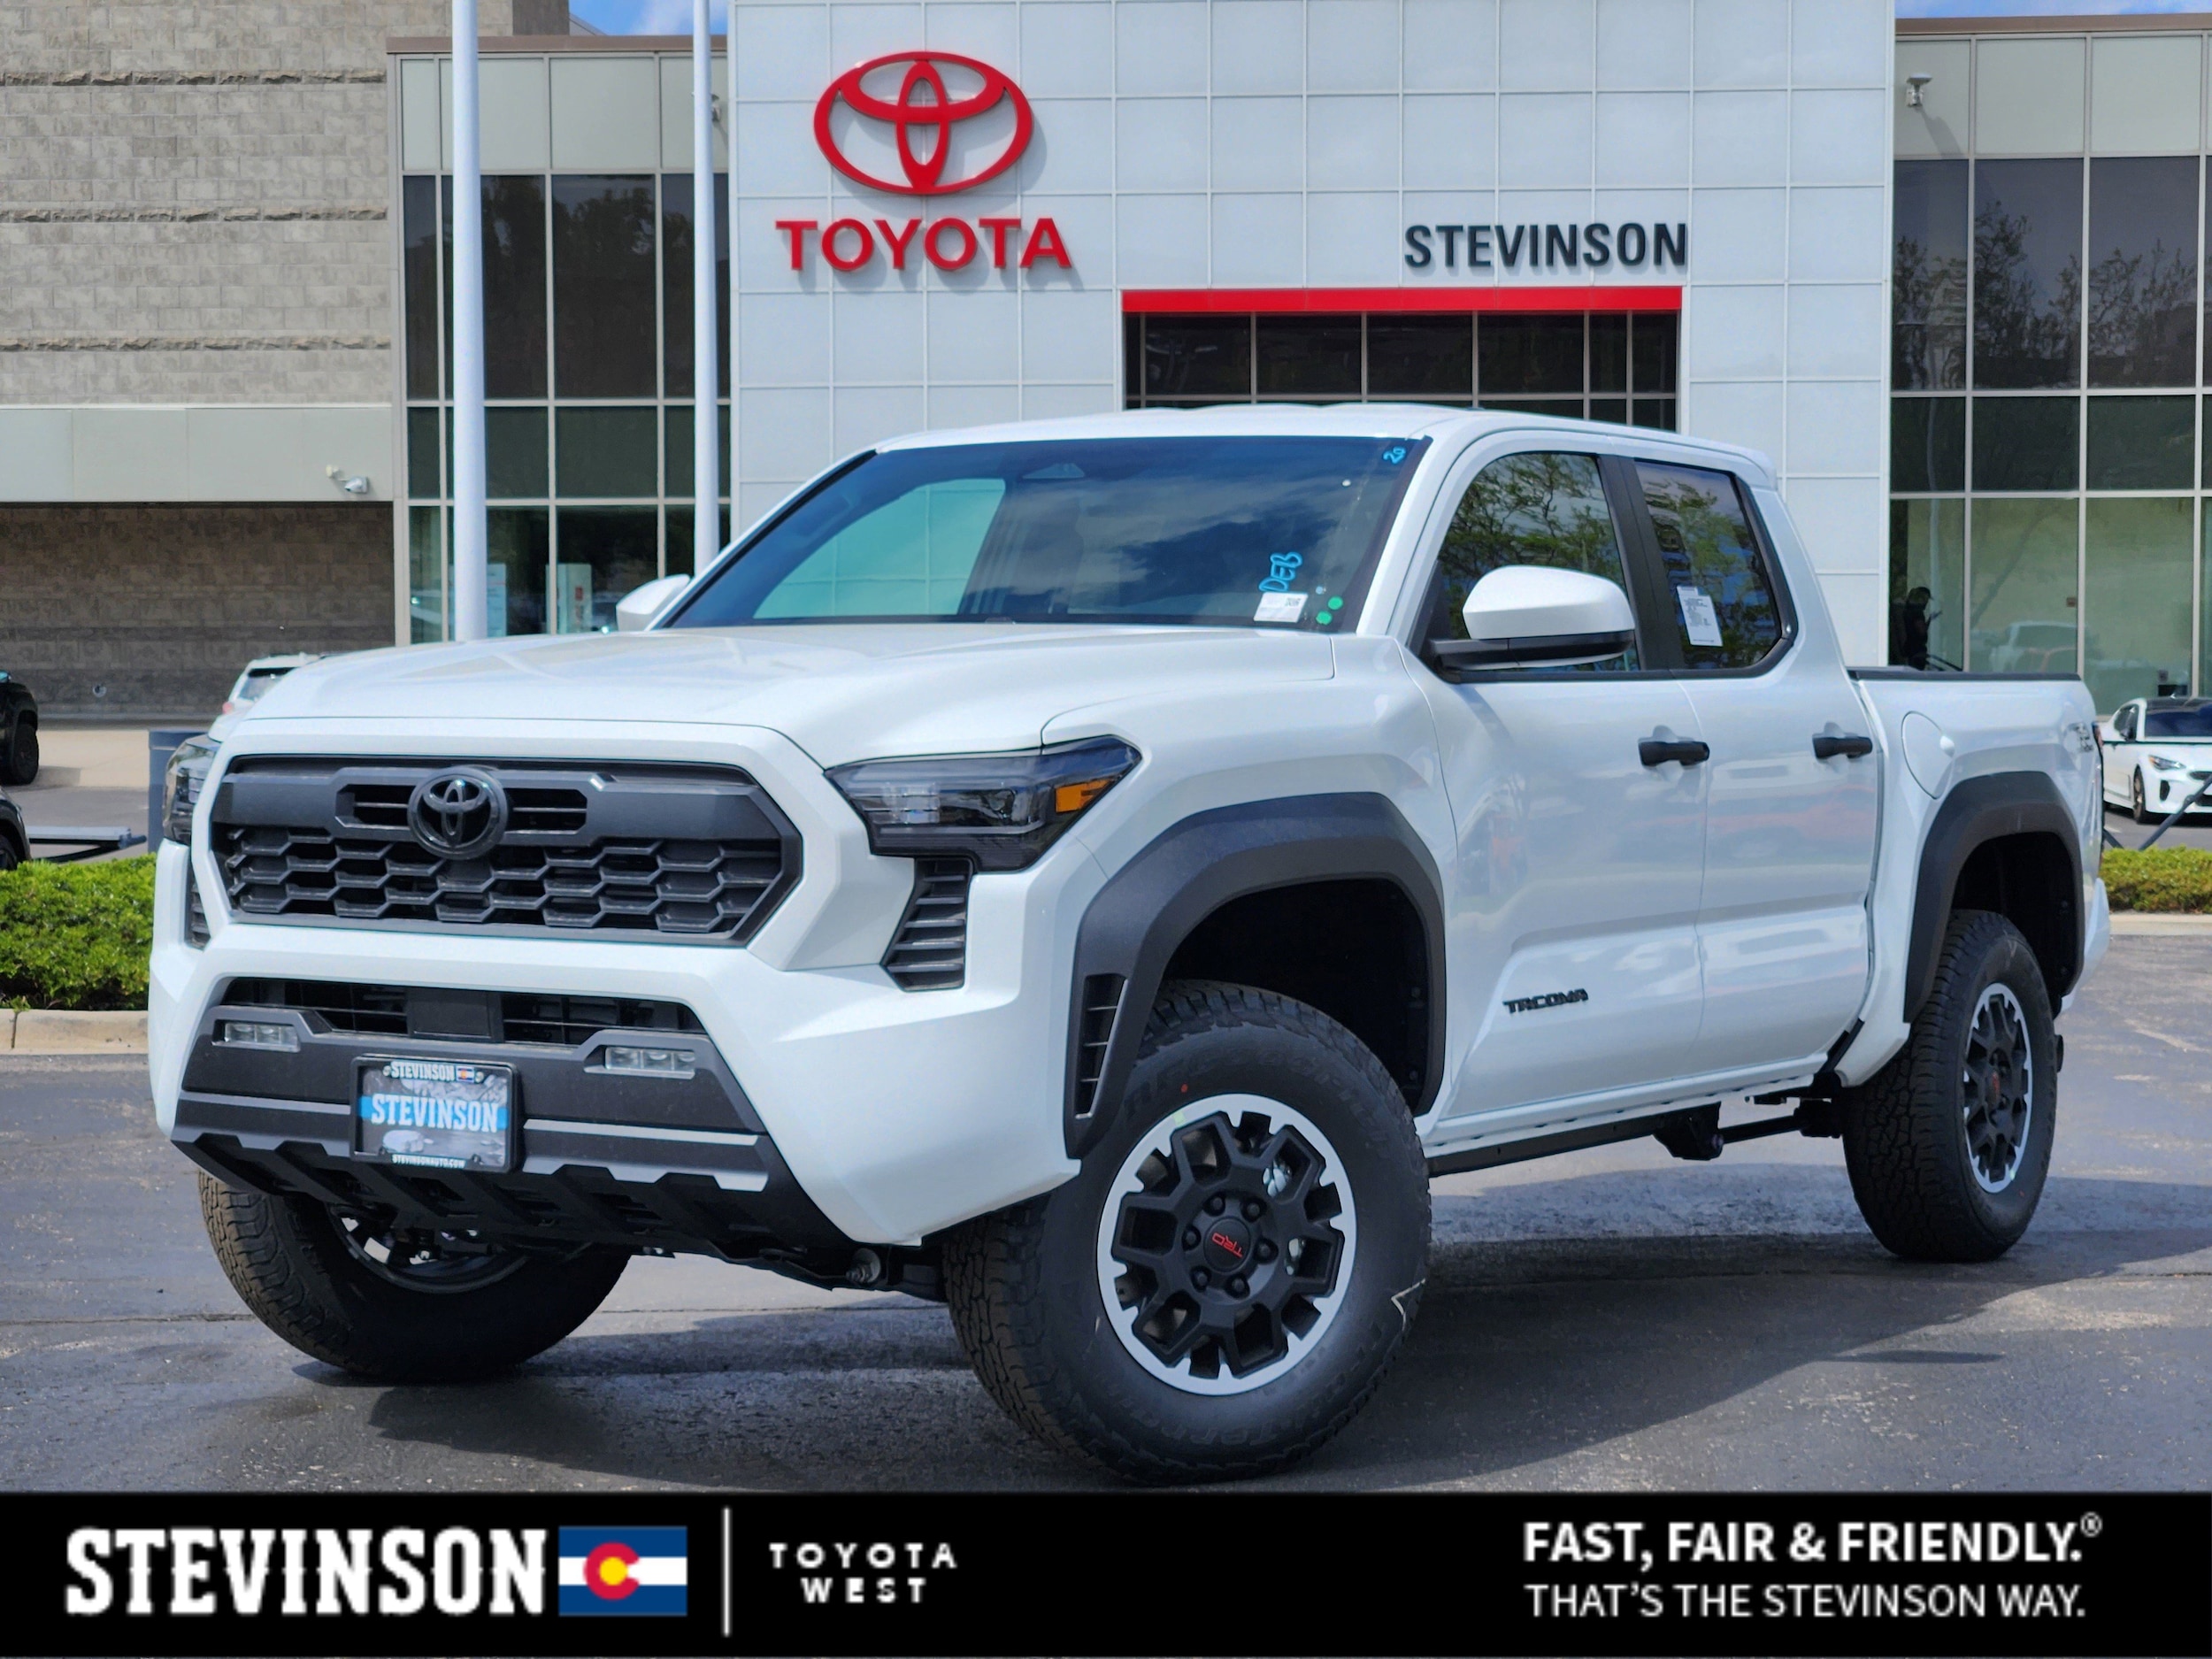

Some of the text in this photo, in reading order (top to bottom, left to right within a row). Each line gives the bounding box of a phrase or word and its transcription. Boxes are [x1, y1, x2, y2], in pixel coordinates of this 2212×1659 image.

[775, 217, 1071, 271] TOYOTA
[1404, 222, 1687, 269] STEVINSON
[1502, 987, 1589, 1014] TACOMA
[390, 1061, 456, 1082] STEVINSON
[371, 1093, 500, 1133] STEVINSON
[1212, 1232, 1243, 1257] TRD
